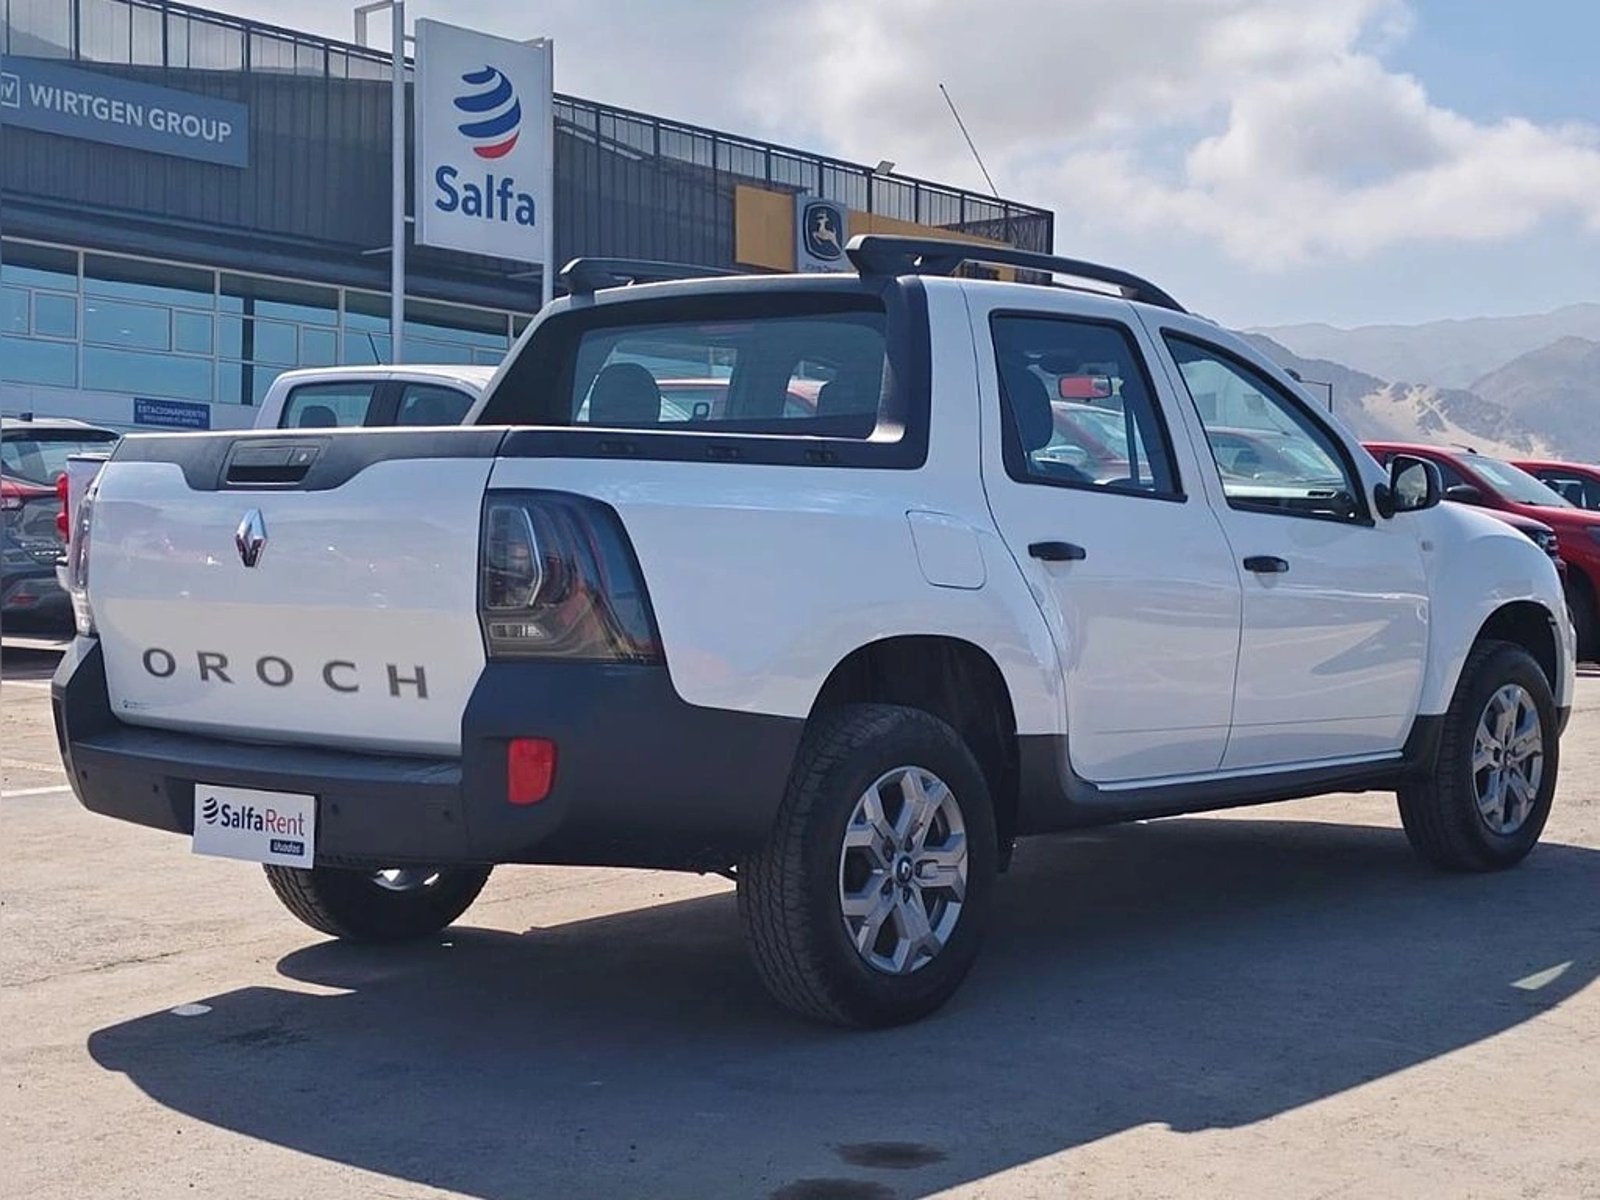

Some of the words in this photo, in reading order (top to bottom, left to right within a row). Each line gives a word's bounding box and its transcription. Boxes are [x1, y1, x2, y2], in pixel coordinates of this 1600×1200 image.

[28, 82, 143, 127] WIRTGEN
[149, 108, 232, 142] GROUP
[435, 165, 535, 226] Salfa
[142, 647, 429, 700] OROCH
[221, 803, 305, 837] SalfaRent
